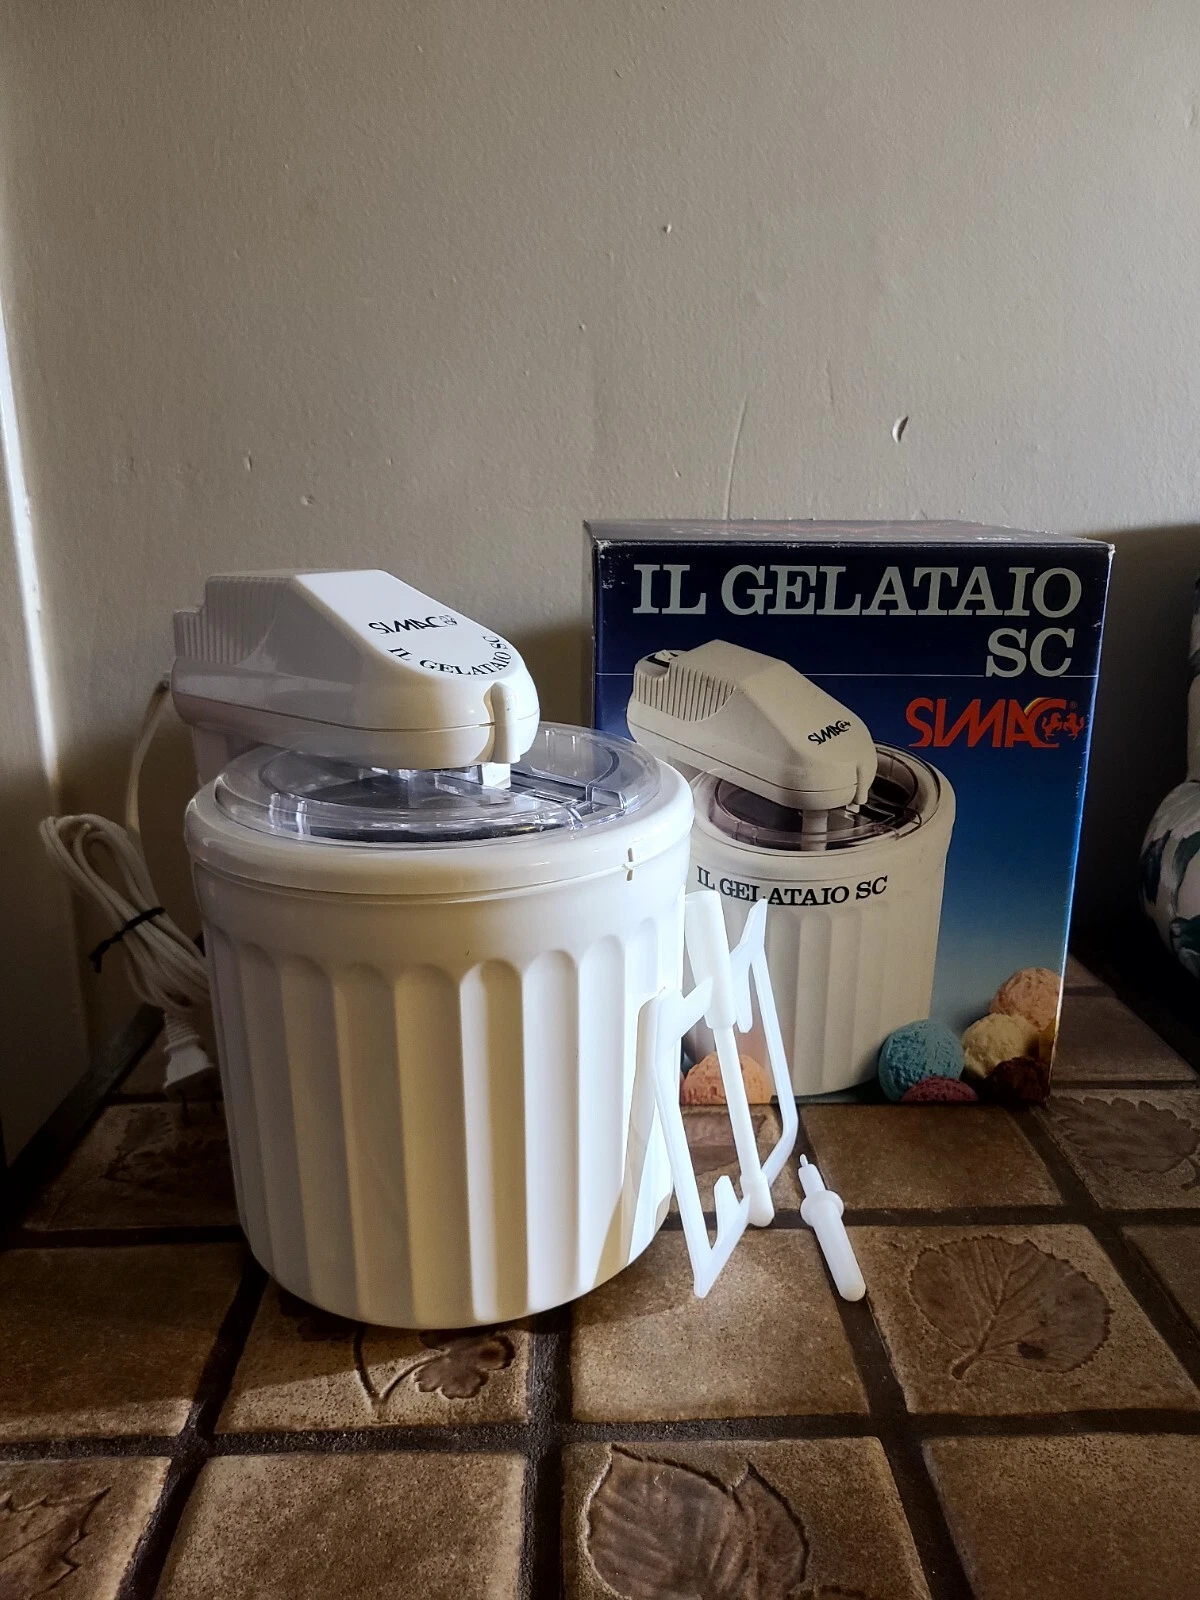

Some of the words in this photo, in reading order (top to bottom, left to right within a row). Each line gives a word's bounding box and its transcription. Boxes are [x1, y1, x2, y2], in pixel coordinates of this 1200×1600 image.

[632, 563, 707, 615] IL
[720, 563, 1083, 618] GELATAIO
[368, 616, 445, 635] SIMAC
[387, 647, 413, 661] IL
[419, 651, 512, 676] GELATAIO
[482, 635, 508, 650] SC
[985, 627, 1075, 678] SC
[807, 720, 850, 745] SIMAC
[905, 697, 1067, 748] SIMAC
[696, 865, 715, 890] IL
[719, 877, 850, 907] GELATAIO
[855, 875, 888, 900] SC
